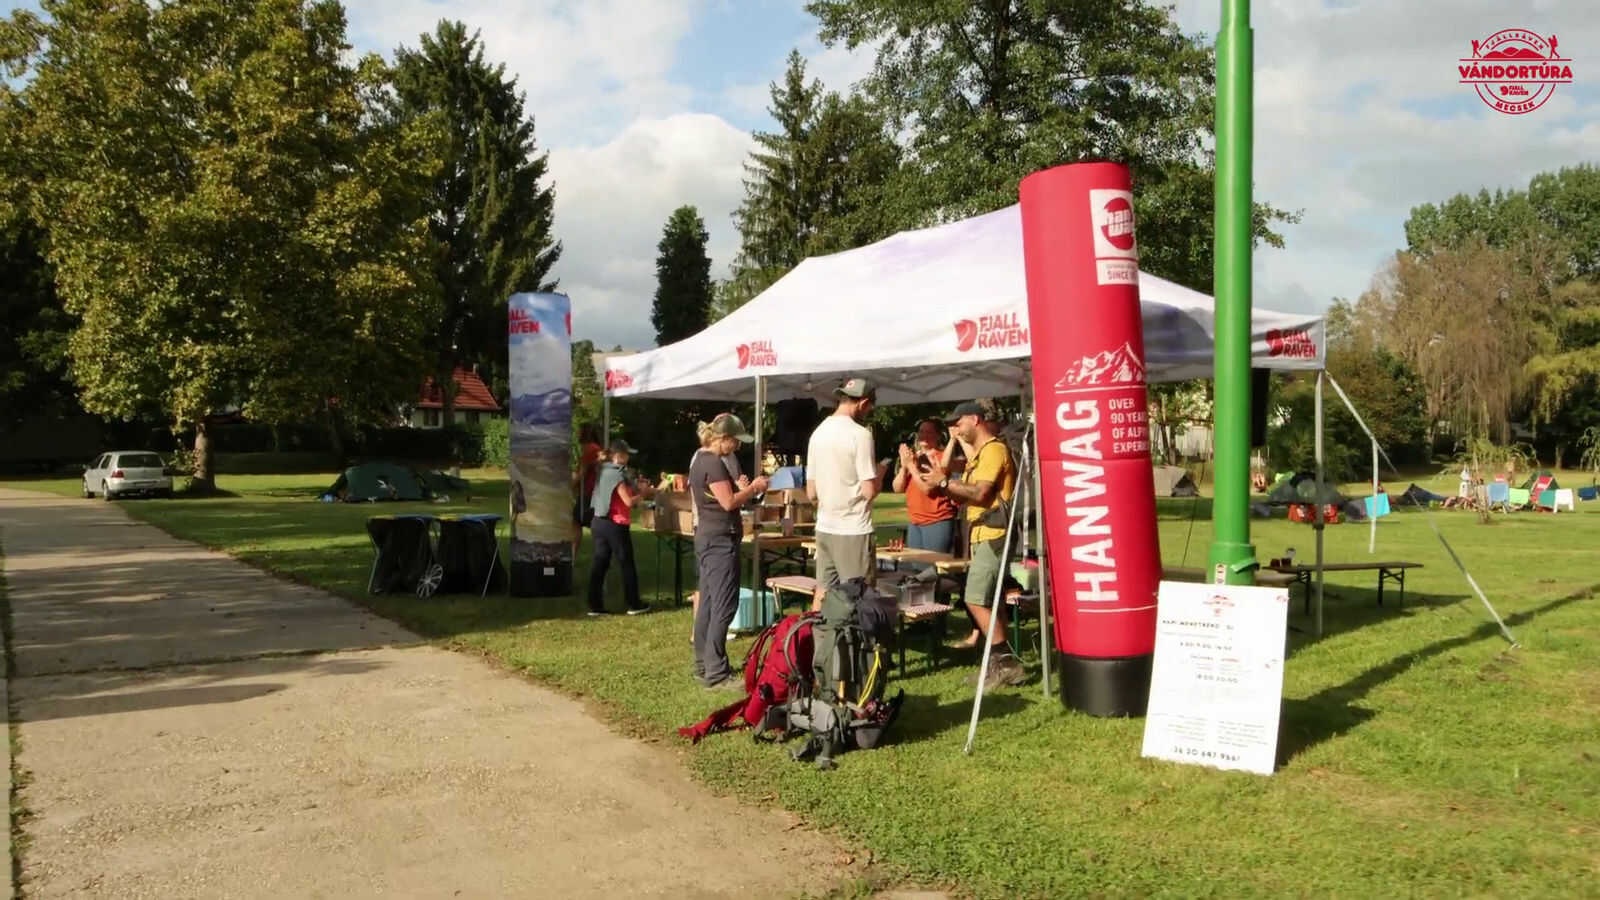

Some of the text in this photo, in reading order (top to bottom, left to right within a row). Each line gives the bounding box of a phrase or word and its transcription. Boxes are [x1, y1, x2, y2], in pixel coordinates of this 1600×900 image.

[1108, 398, 1136, 410] OVER
[1110, 412, 1125, 425] 90
[1112, 426, 1125, 440] OF
[1056, 399, 1120, 602] HANWAG
